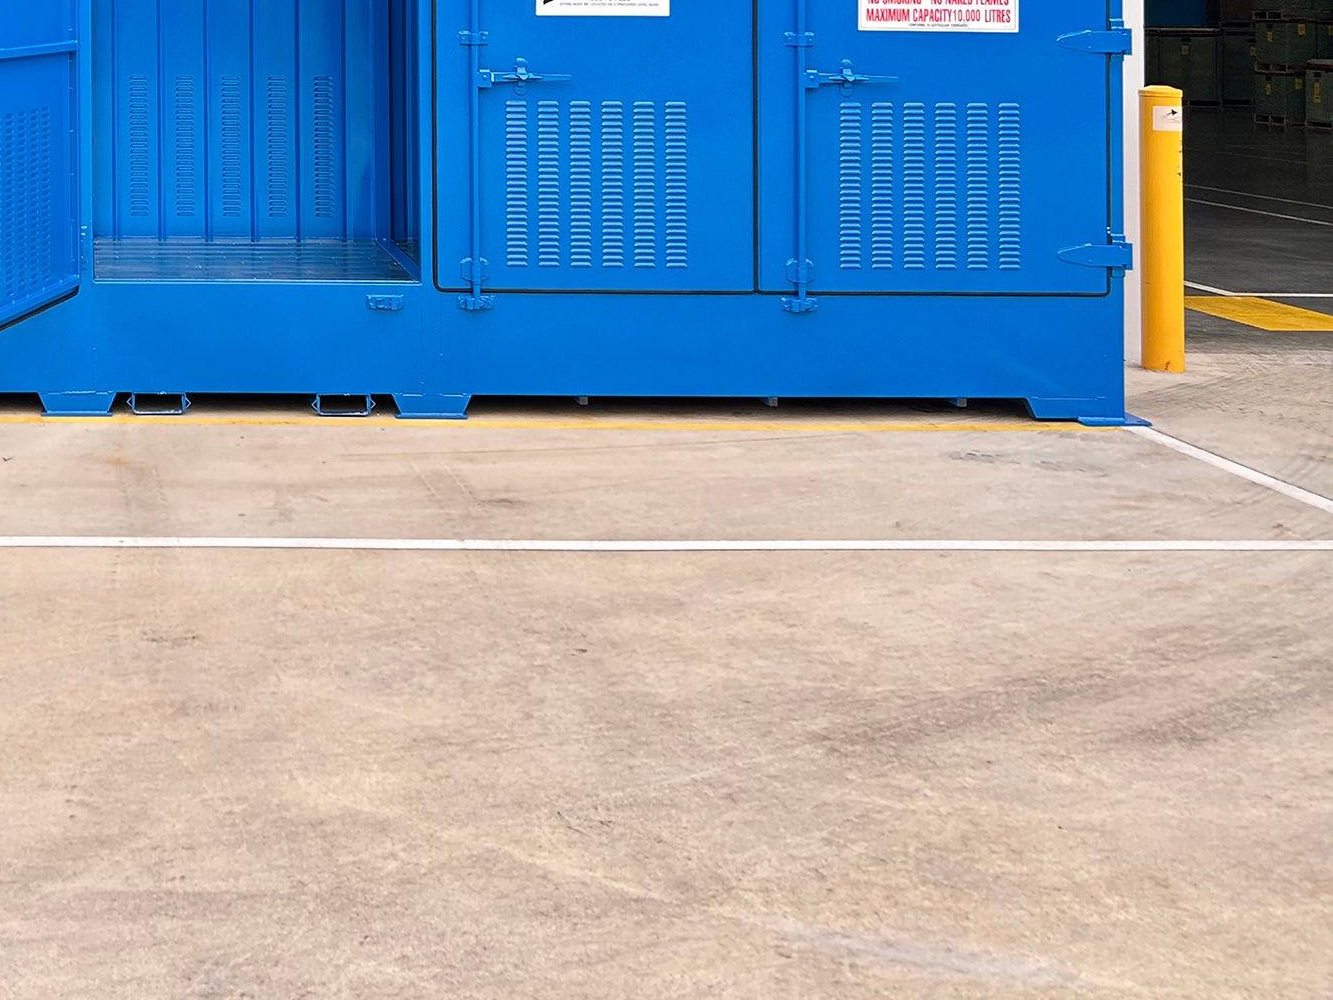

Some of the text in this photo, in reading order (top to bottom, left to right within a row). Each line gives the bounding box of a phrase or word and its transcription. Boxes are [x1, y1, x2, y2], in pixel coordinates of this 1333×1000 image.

[866, 9, 910, 22] MAXIMUM
[912, 9, 952, 22] CAPACITY
[984, 10, 1011, 23] LITRES
